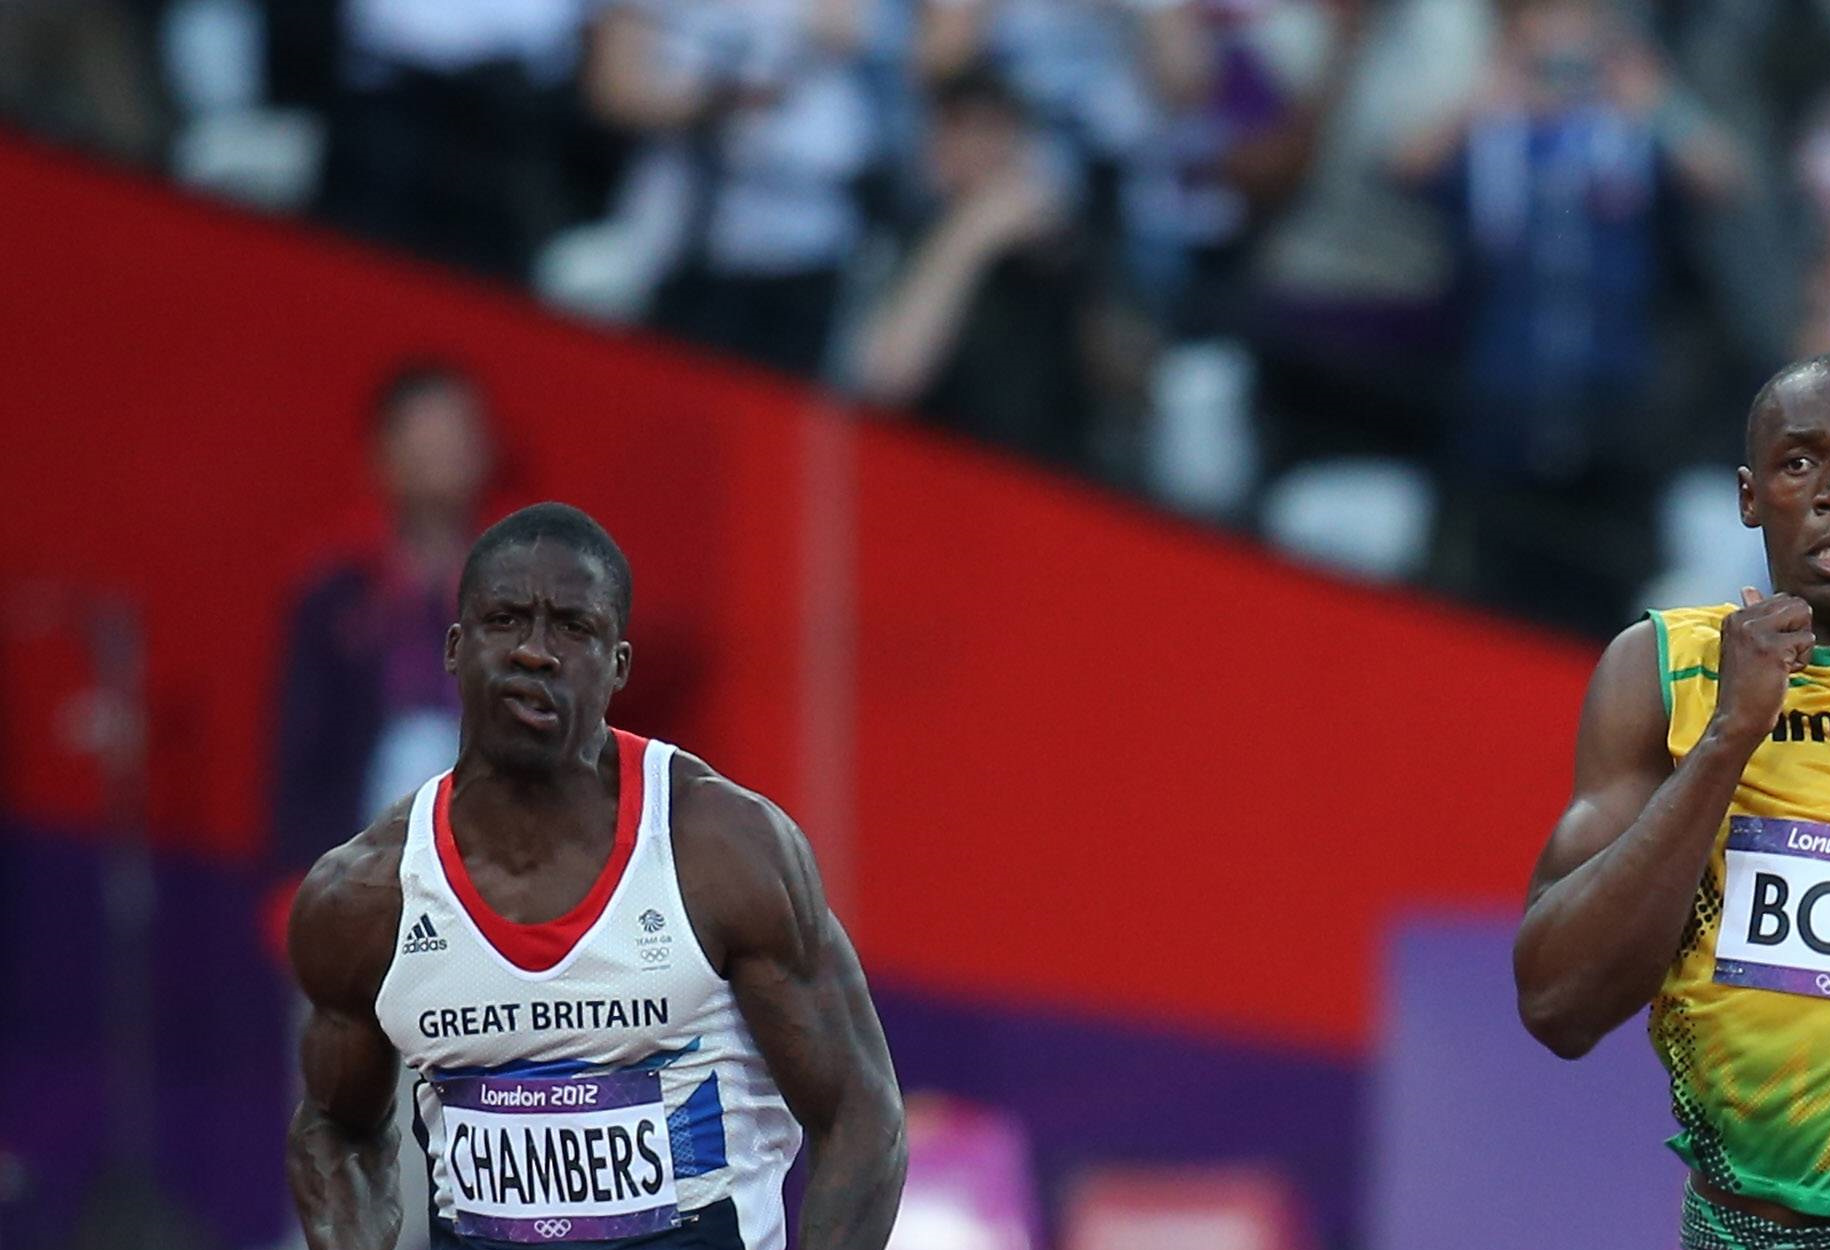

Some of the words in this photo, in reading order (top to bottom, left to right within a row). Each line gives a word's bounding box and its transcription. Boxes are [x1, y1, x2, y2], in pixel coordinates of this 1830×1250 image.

[402, 938, 448, 955] adidas
[418, 1003, 521, 1038] GREAT
[532, 997, 669, 1031] BRITAIN
[480, 1083, 547, 1107] London
[551, 1084, 599, 1105] 2012
[450, 1119, 665, 1205] CHAMBERS
